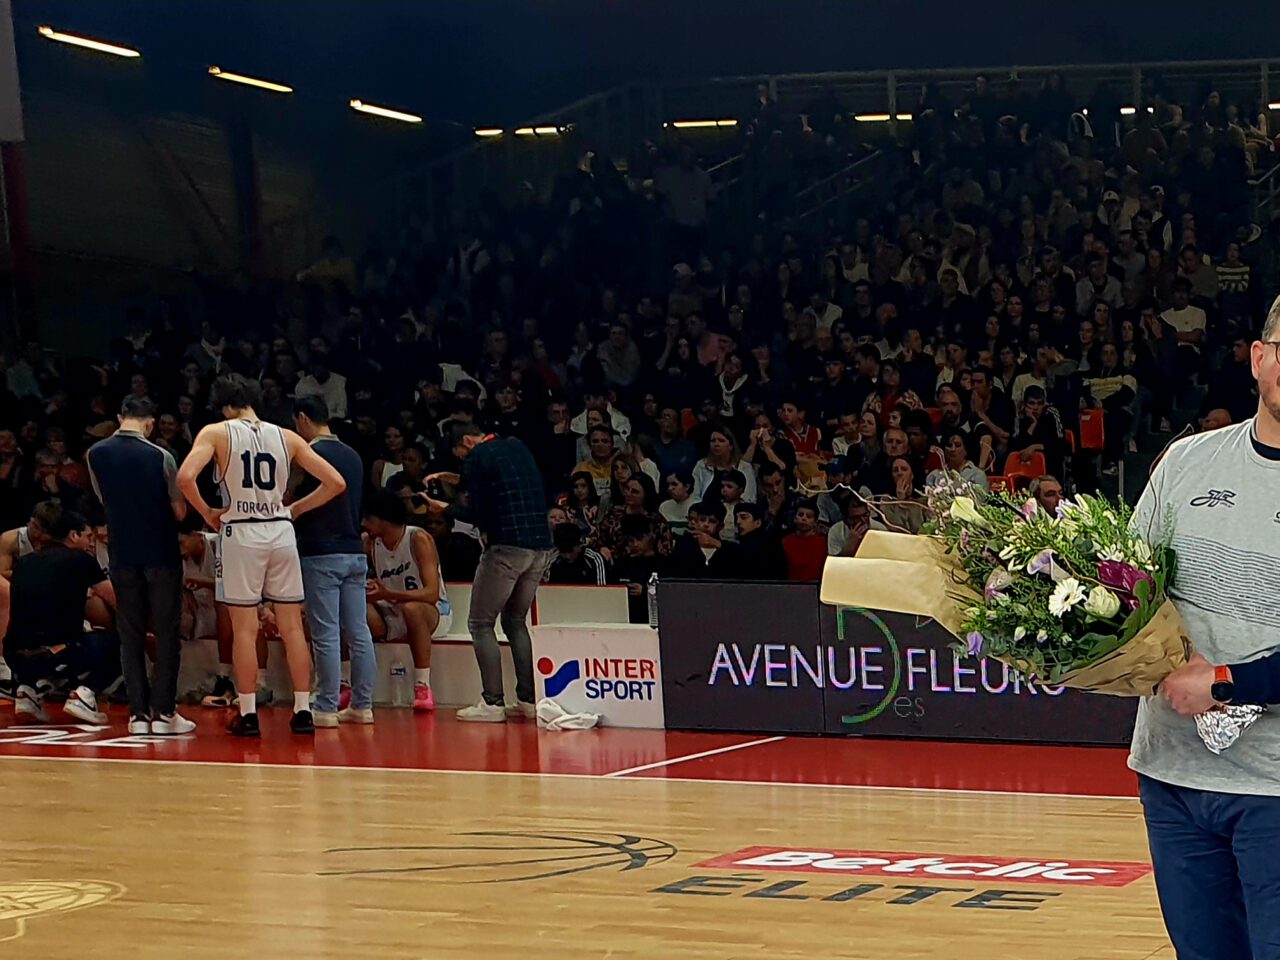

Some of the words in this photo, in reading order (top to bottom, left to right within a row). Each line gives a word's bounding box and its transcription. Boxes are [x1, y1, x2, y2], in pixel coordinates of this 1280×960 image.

[241, 450, 276, 490] 10
[584, 658, 655, 679] INTER
[708, 642, 884, 690] AVENUE
[907, 648, 1065, 695] FLEU
[585, 679, 656, 700] SPORT
[733, 850, 1118, 881] Betclic
